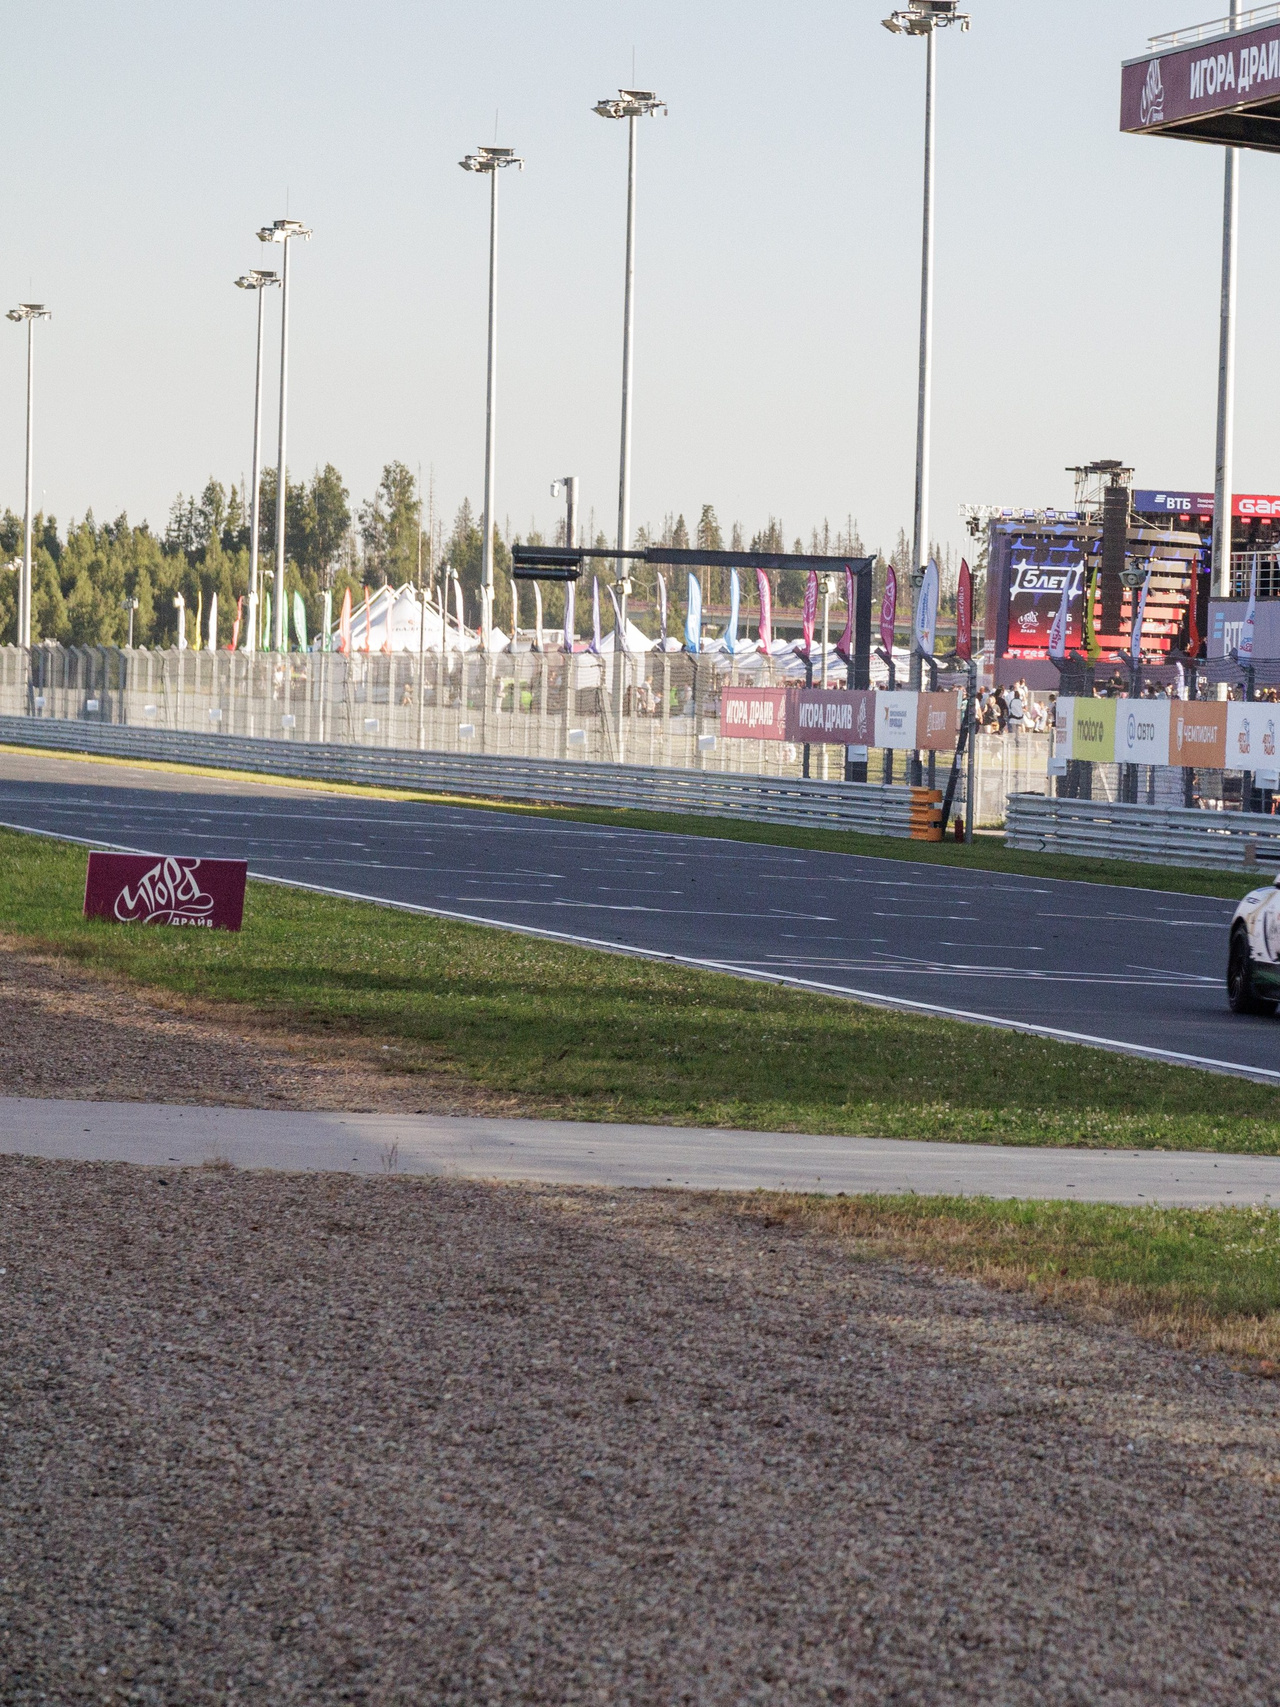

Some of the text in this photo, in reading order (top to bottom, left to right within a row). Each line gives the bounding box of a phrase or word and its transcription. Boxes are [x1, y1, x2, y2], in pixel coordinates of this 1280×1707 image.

[1190, 52, 1235, 99] ИГОРА
[1166, 497, 1192, 510] ВТБ
[1223, 621, 1245, 659] ВТ
[726, 700, 749, 724] ИГОРА
[799, 703, 823, 728] ИГОРА
[1184, 725, 1219, 744] ЧЕМПИОНАТ
[172, 917, 213, 927] ДРАЙВ
